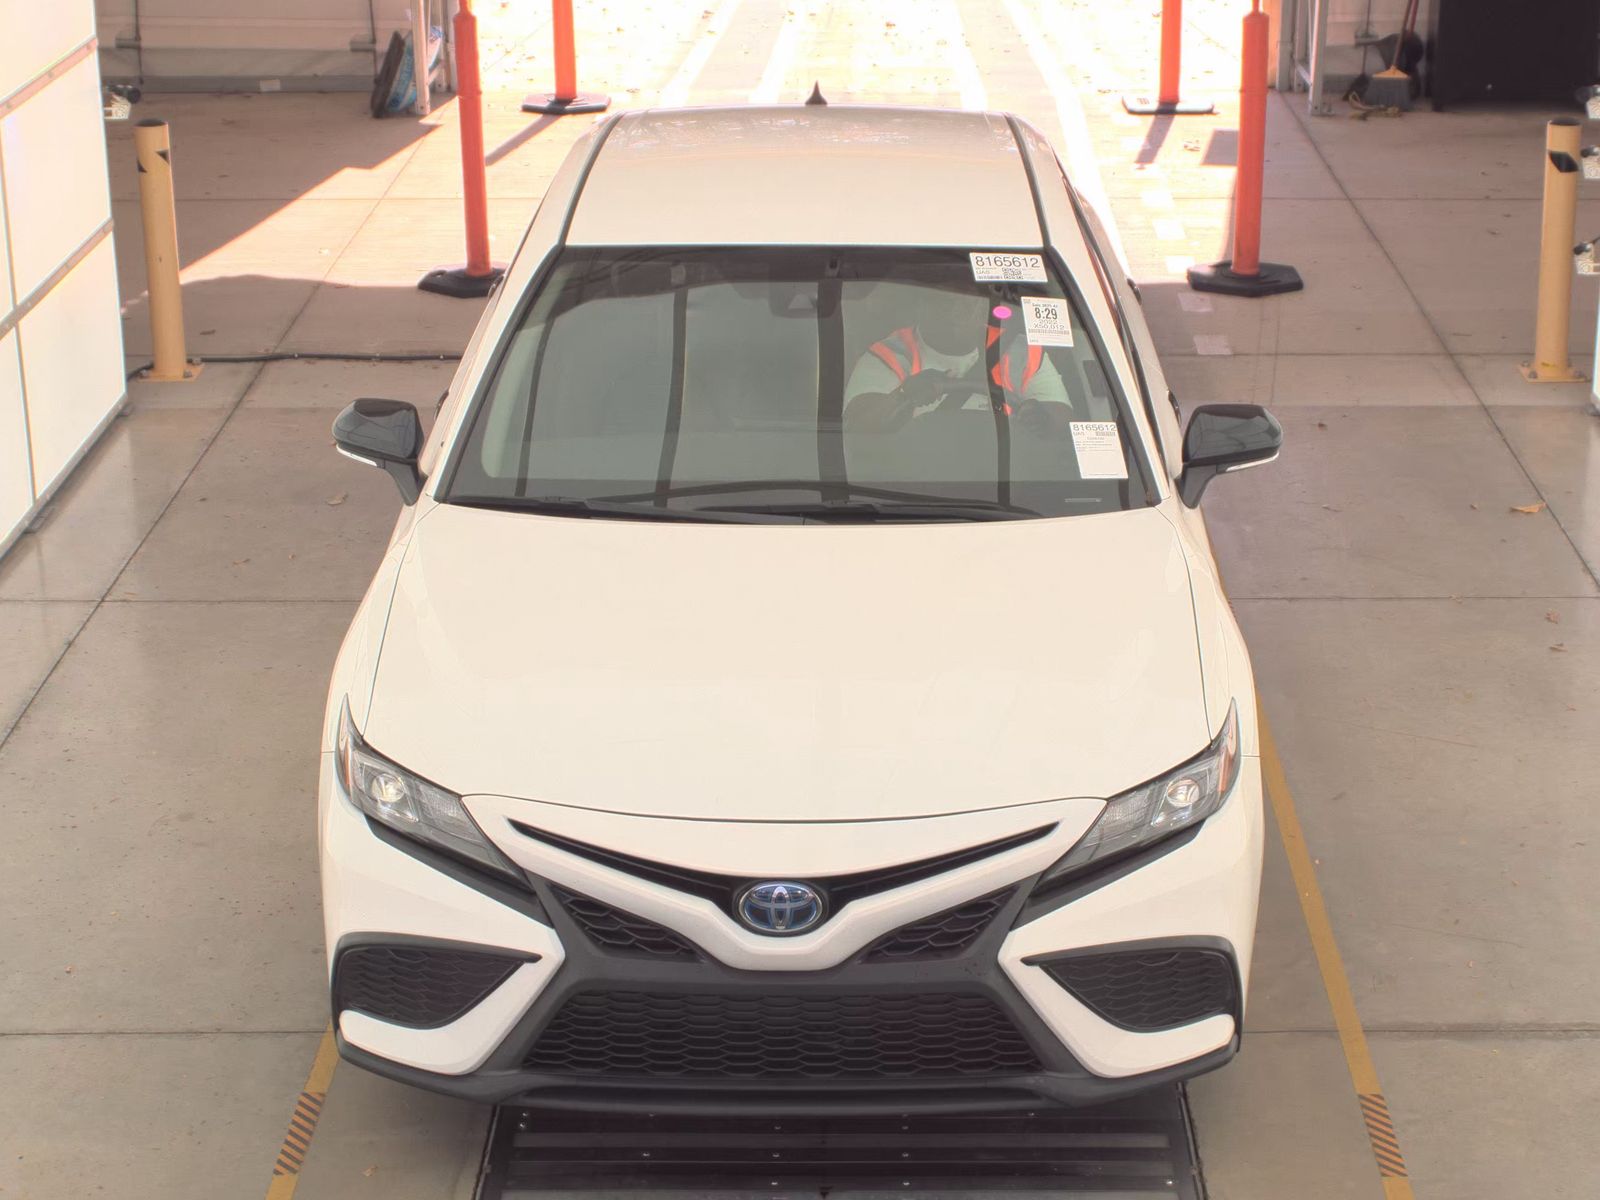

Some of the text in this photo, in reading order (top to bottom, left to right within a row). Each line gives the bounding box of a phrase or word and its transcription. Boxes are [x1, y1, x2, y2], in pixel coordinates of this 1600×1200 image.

[975, 255, 1041, 268] 8165612
[1034, 307, 1058, 320] 8:29
[1072, 423, 1117, 432] 8165612
